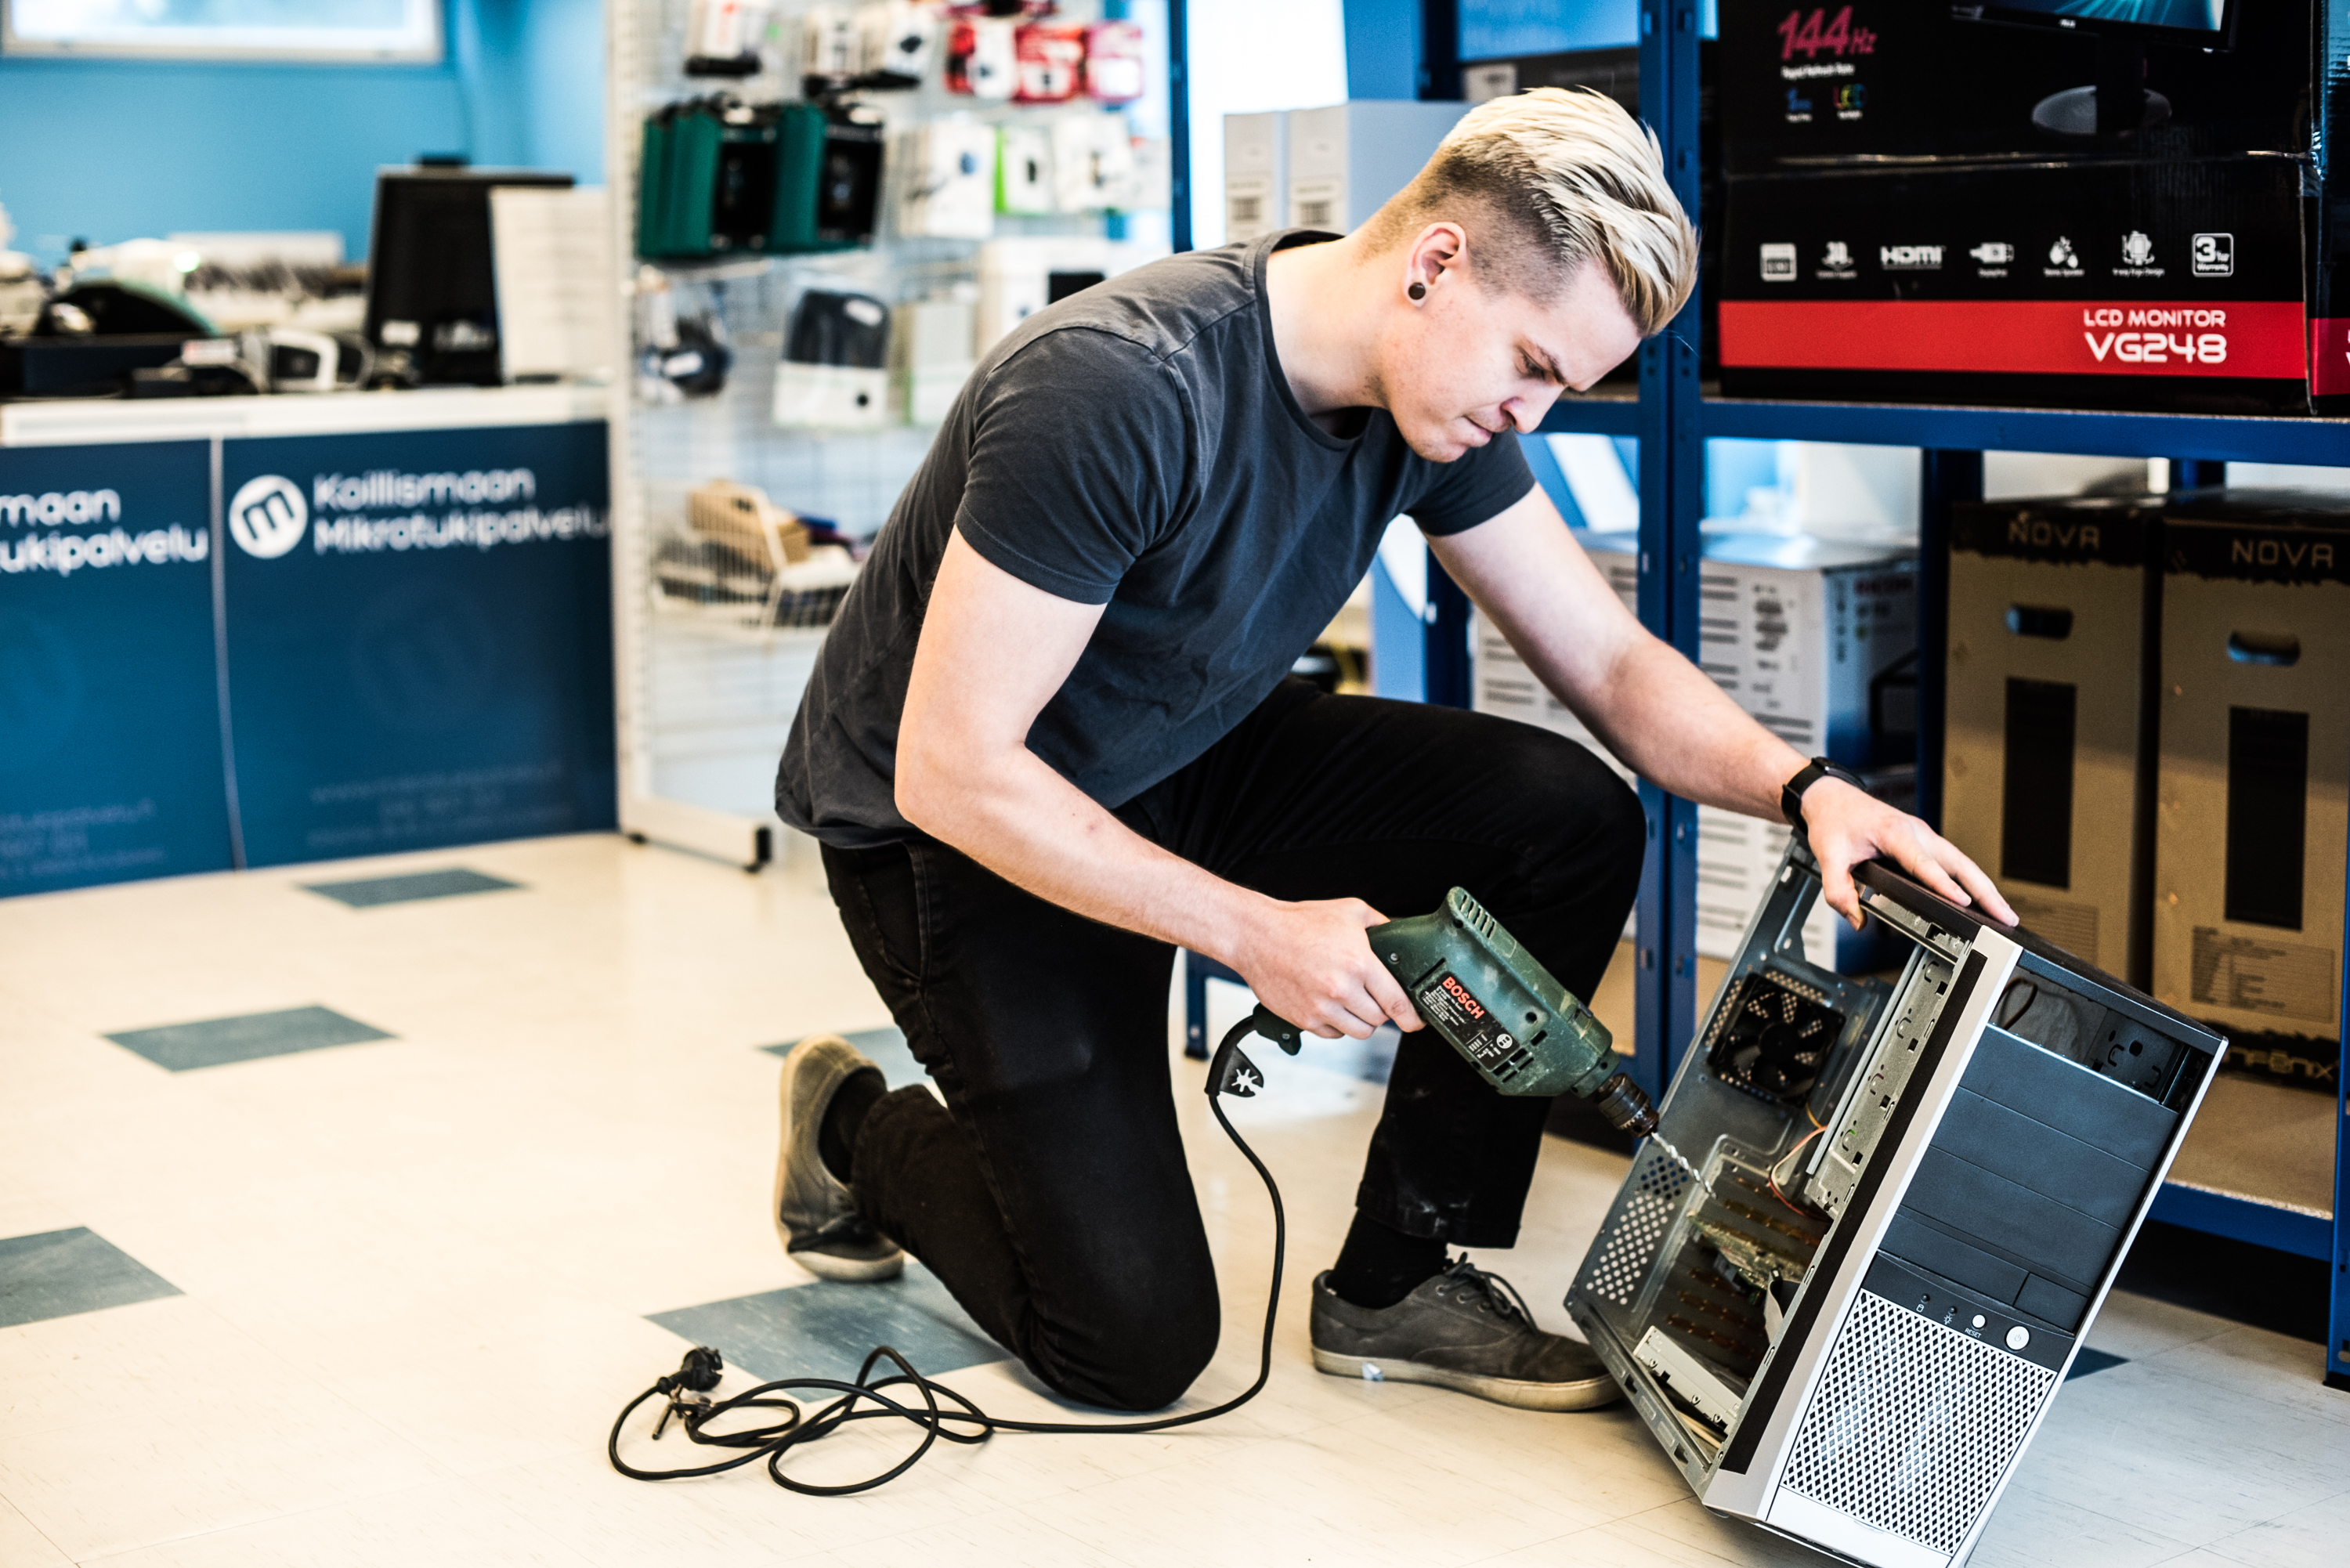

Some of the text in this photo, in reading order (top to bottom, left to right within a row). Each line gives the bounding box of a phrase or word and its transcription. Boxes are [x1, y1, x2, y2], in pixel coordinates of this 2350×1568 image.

[1881, 245, 1942, 265] HDMI
[2196, 237, 2216, 262] 3
[2084, 309, 2226, 327] LCD MONITOR
[2083, 331, 2227, 363] VG248
[2008, 521, 2100, 551] NOVA
[2232, 538, 2334, 569] NOVA
[1442, 976, 1484, 1019] BOSCH
[1965, 1328, 1982, 1339] RESET
